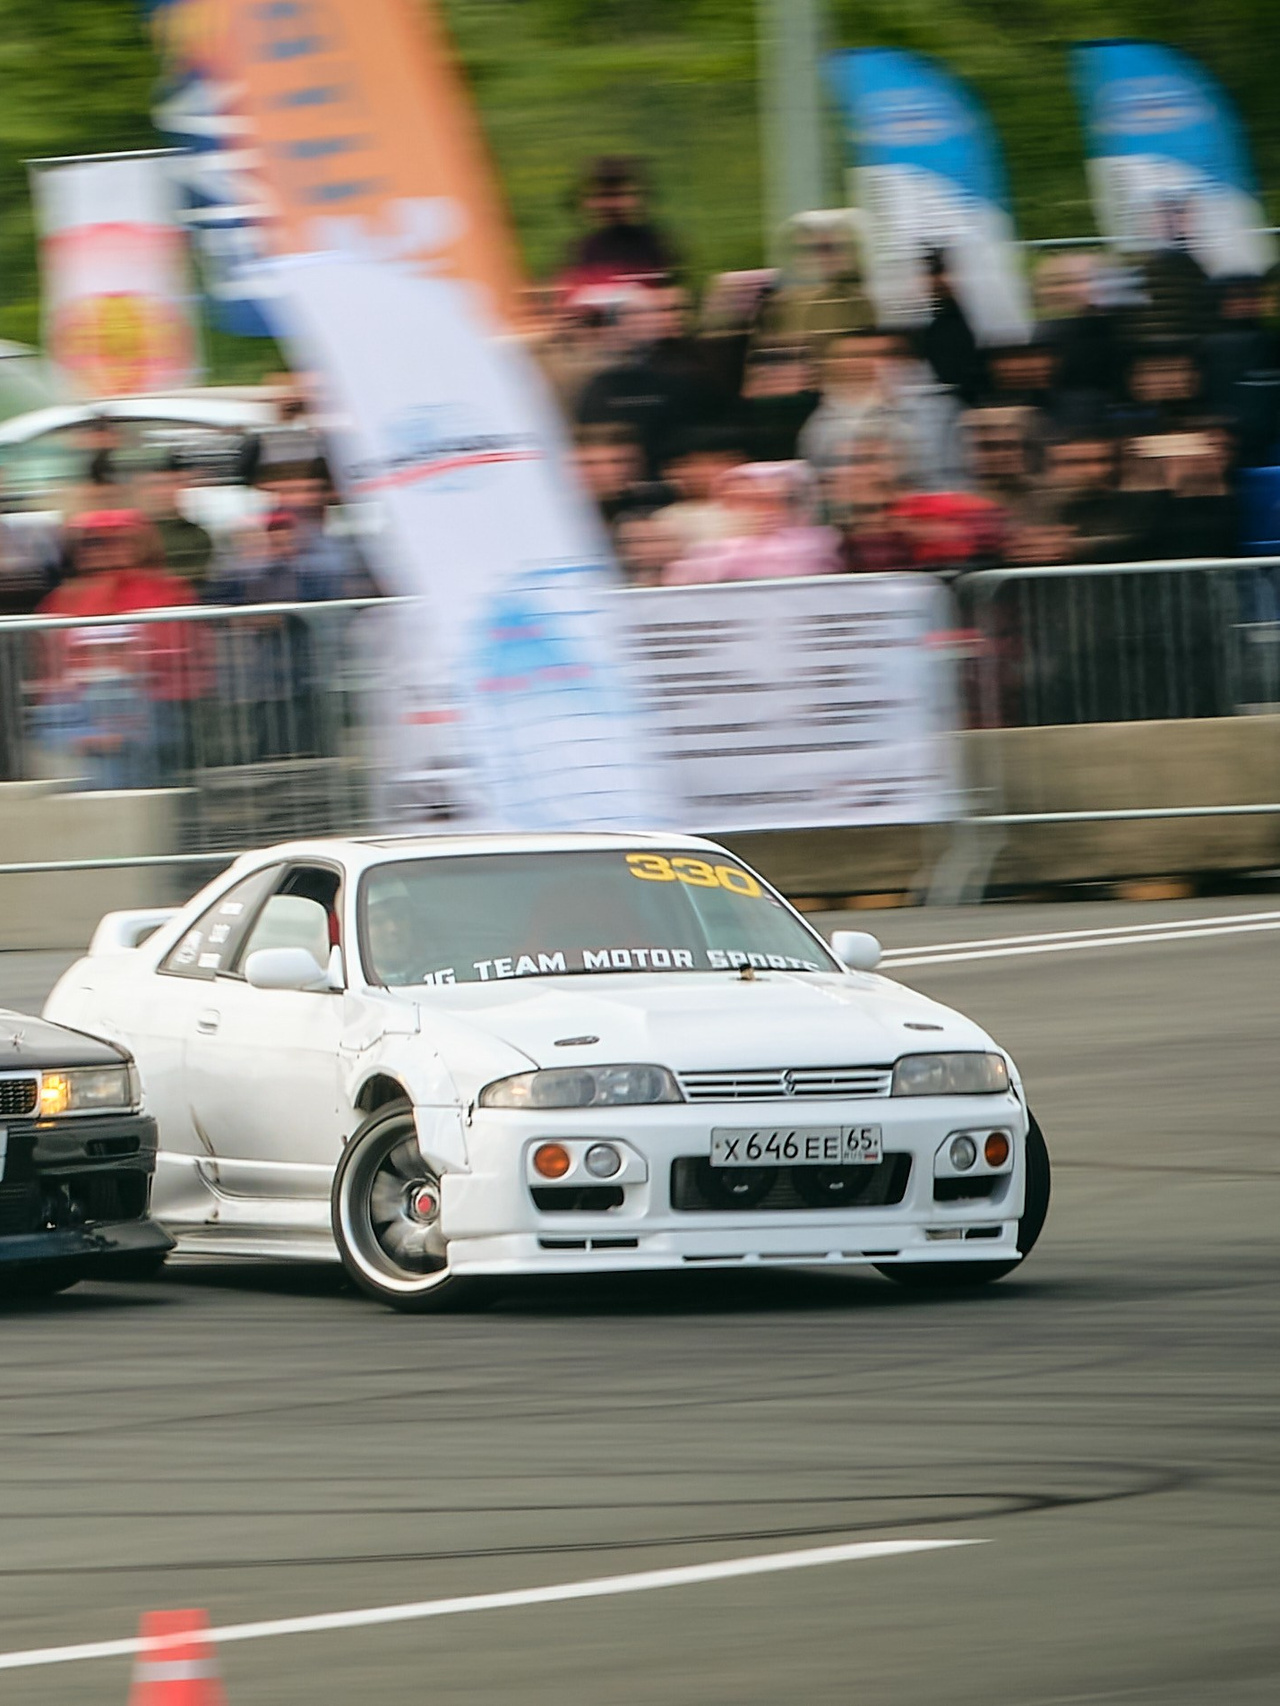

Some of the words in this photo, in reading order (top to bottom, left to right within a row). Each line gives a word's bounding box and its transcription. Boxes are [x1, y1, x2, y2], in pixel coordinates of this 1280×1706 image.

[625, 853, 762, 898] 330
[473, 952, 566, 981] TEAM
[583, 949, 694, 969] MOTOR
[847, 1128, 872, 1151] 65
